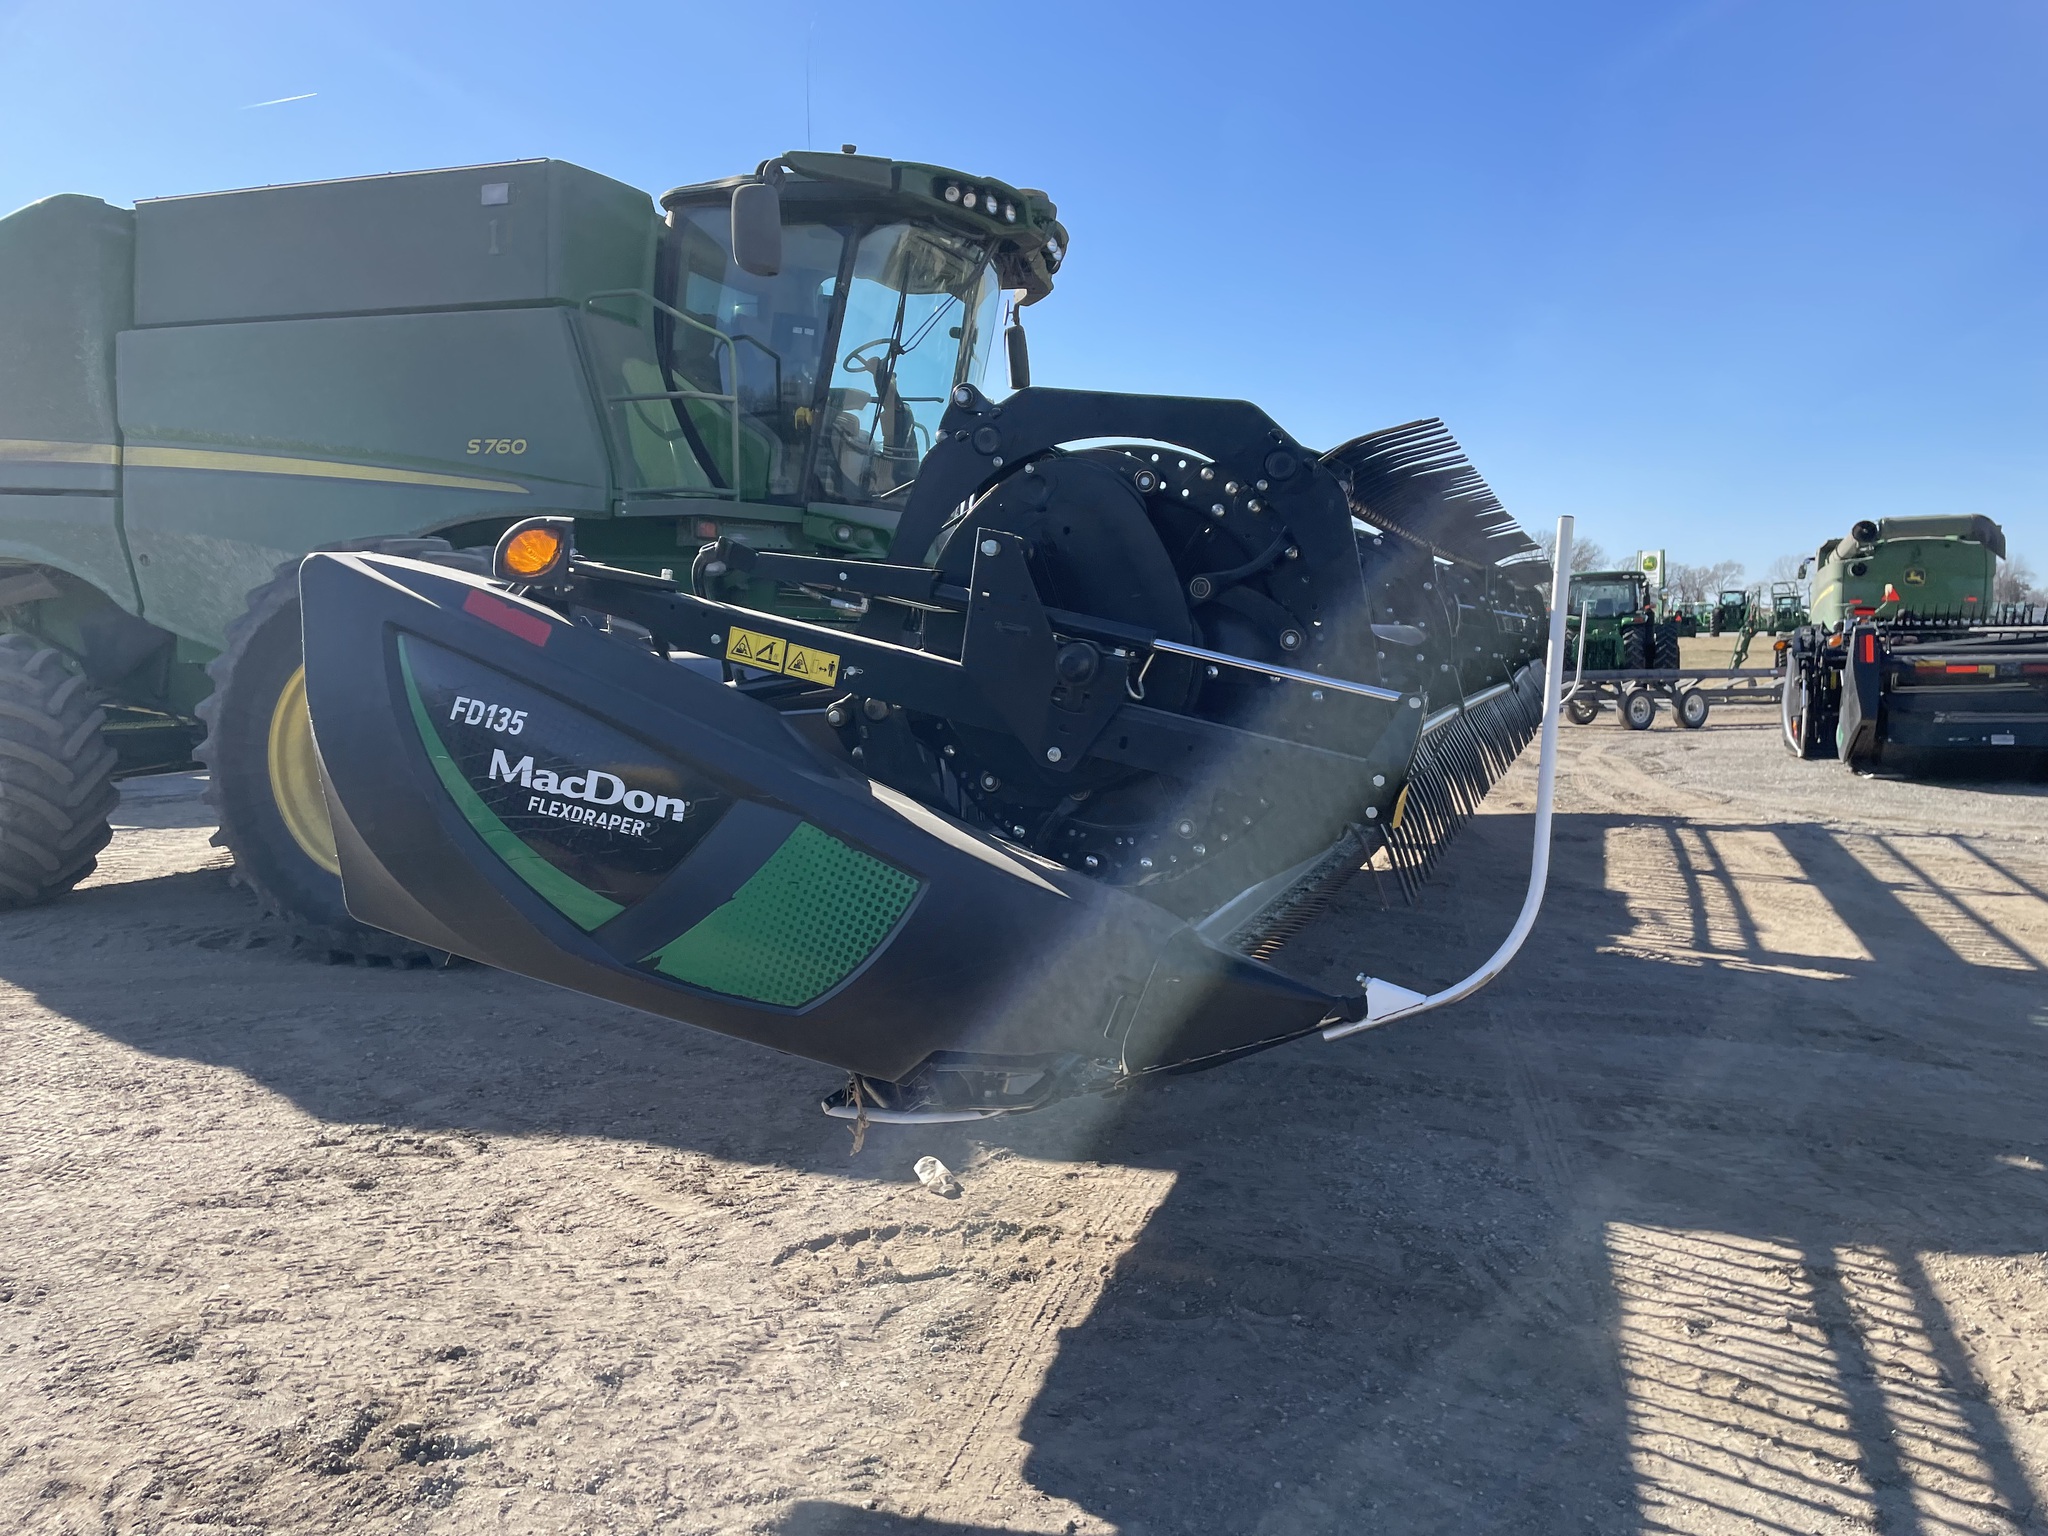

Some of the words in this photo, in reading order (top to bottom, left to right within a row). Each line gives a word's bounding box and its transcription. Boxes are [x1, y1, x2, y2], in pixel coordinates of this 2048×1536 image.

[450, 696, 529, 735] FD135
[488, 748, 686, 823] MacDon
[527, 796, 646, 837] FLEXDRAPER
